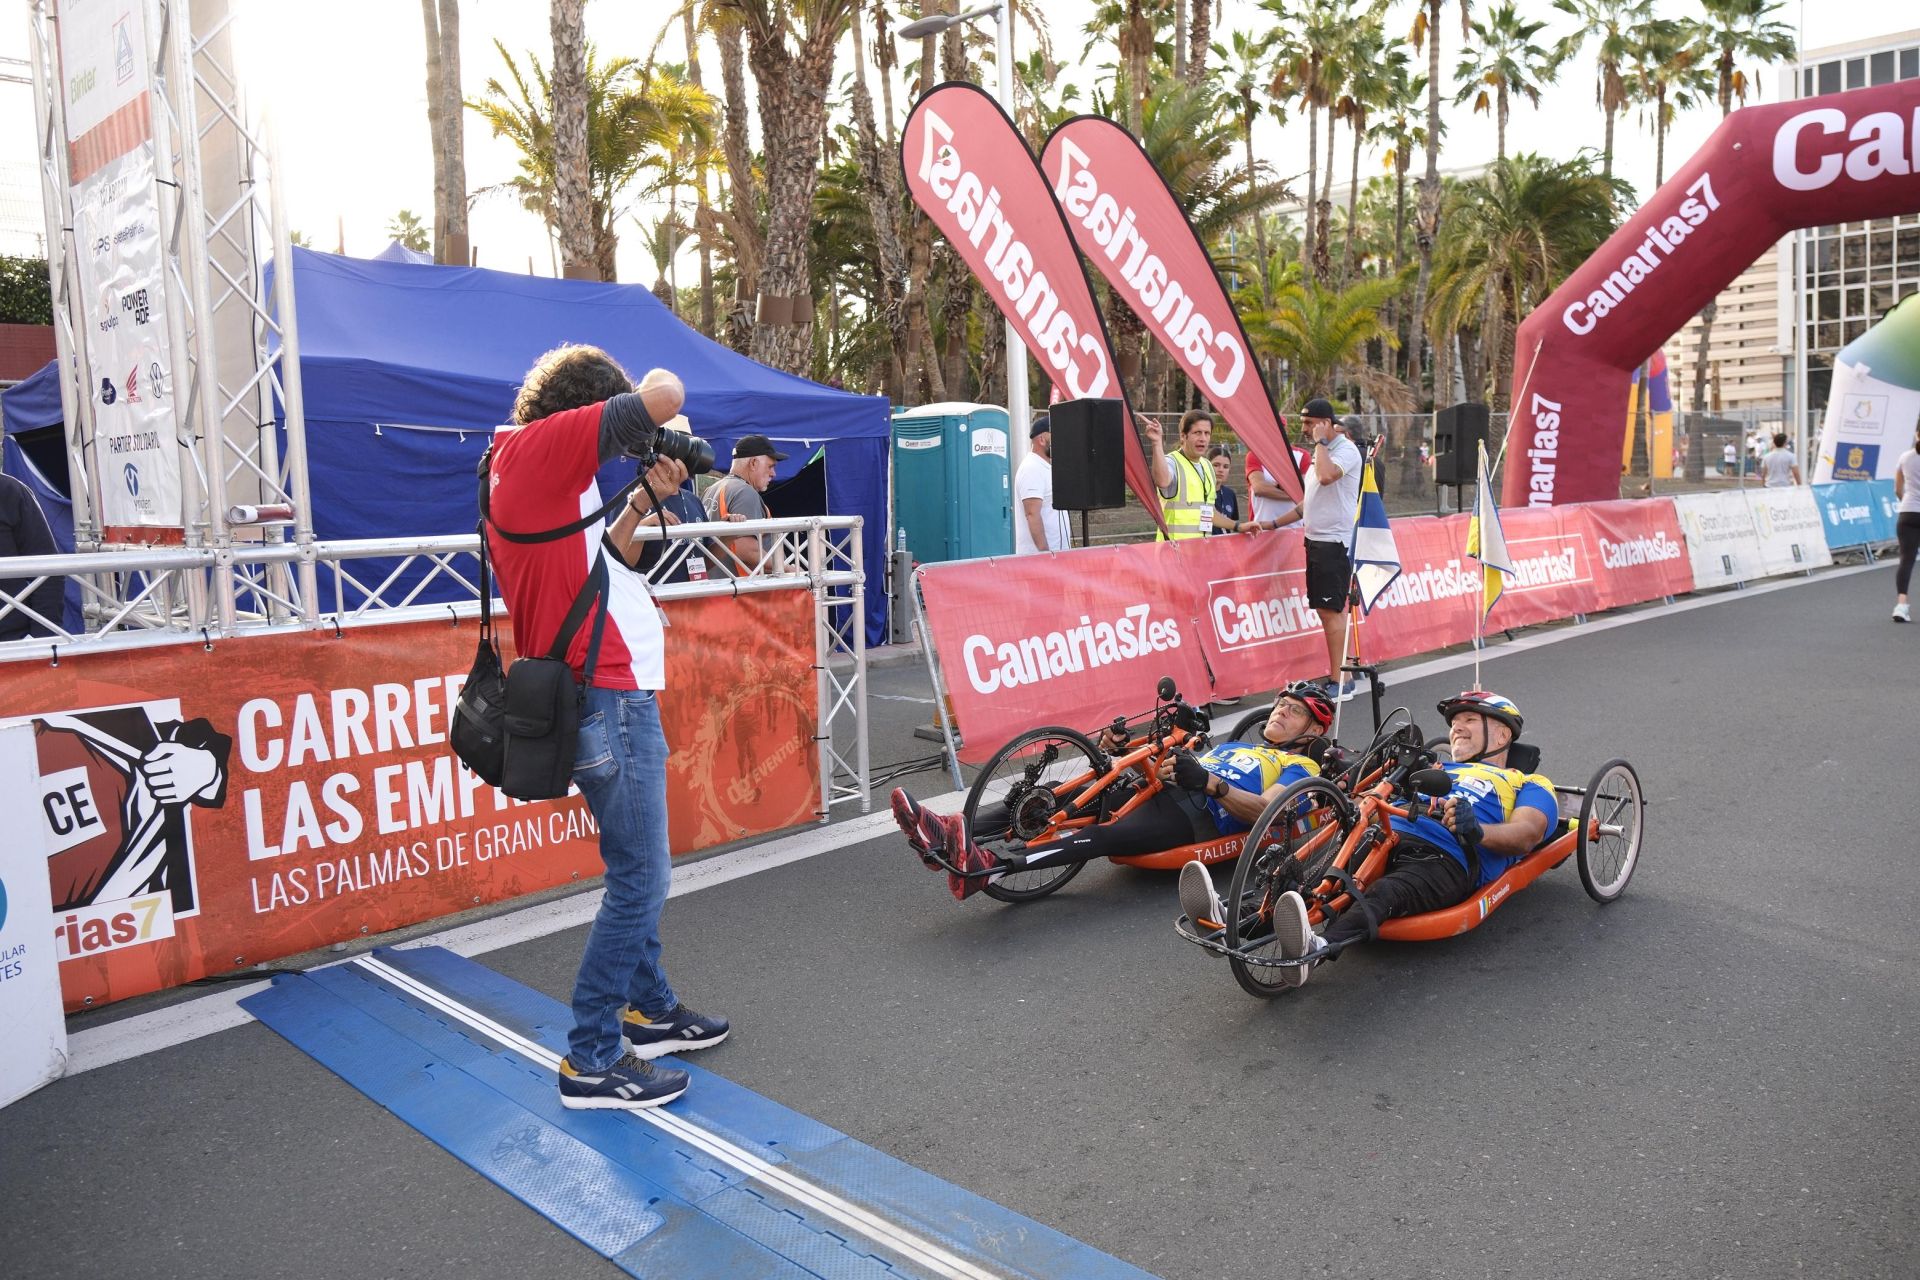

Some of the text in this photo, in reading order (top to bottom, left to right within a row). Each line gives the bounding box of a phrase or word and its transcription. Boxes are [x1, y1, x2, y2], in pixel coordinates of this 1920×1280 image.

[70, 66, 97, 105] Binter
[1563, 172, 1720, 335] Canarias7
[122, 289, 149, 312] POWER
[135, 306, 150, 326] ADE
[963, 603, 1181, 694] Canarias7.es
[755, 735, 801, 783] EVENTOS
[43, 782, 98, 835] CE
[243, 772, 364, 861] LAS
[251, 807, 600, 913] LAS PALMAS DE GRAN CAN
[1194, 840, 1238, 861] TALLER
